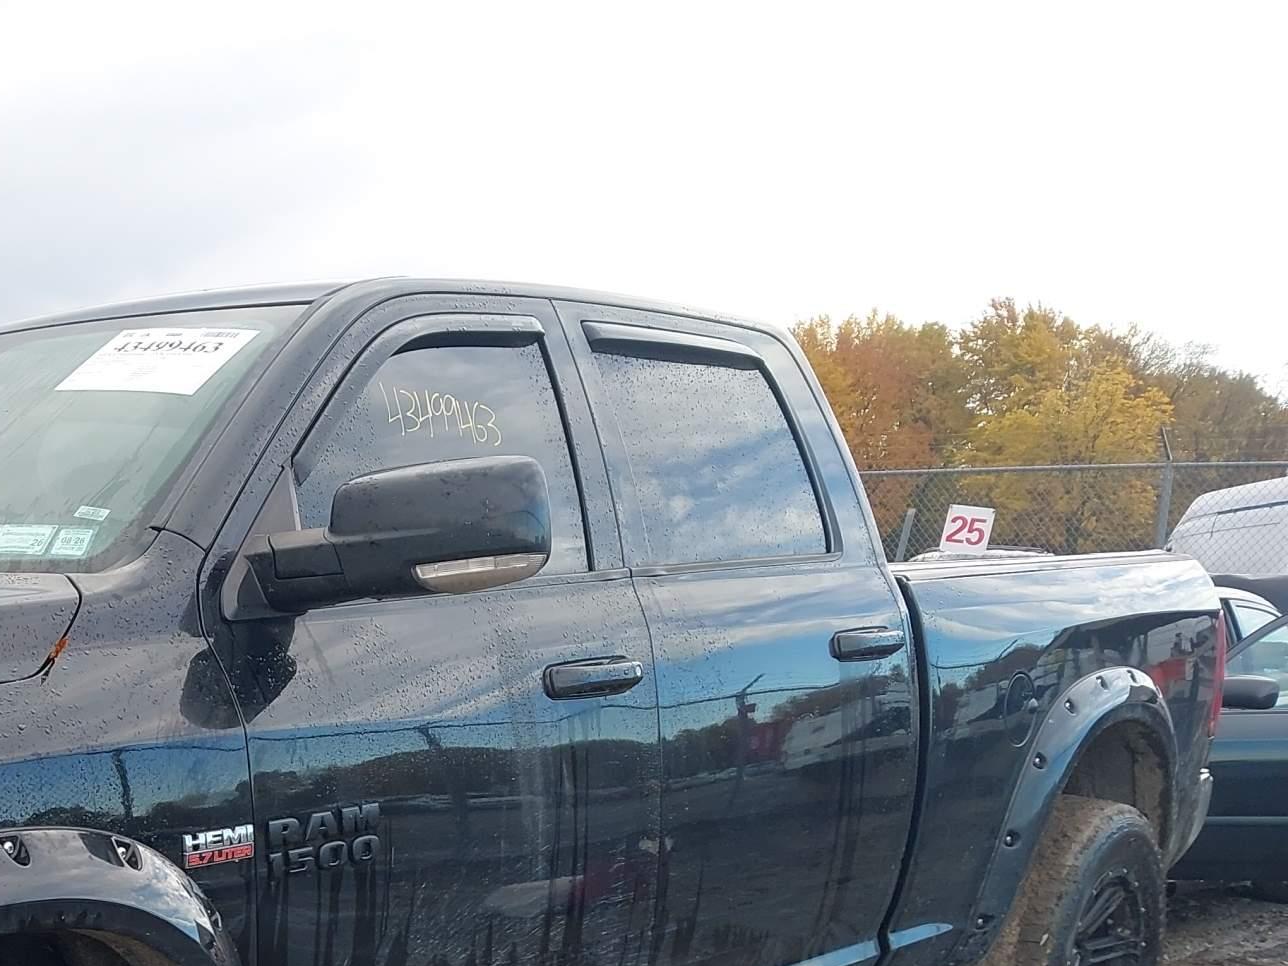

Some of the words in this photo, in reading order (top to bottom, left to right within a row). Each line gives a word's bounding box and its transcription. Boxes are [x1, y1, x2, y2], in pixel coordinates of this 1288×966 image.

[379, 382, 503, 447] 43499463
[945, 515, 987, 546] 25
[182, 824, 254, 853] HEMI
[269, 803, 380, 849] RAM
[269, 835, 381, 877] 1500
